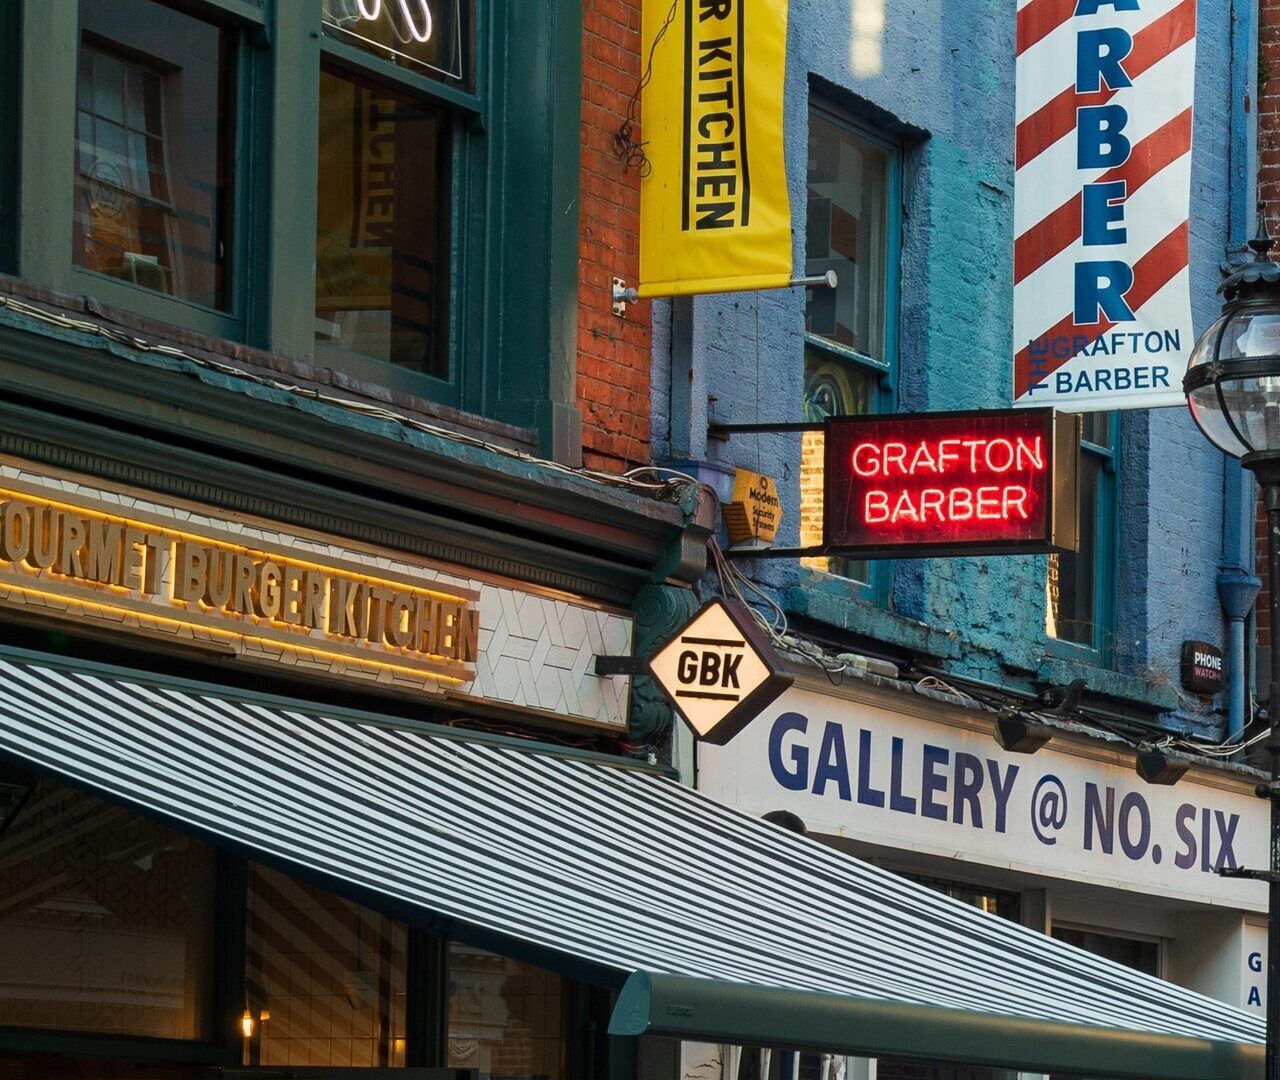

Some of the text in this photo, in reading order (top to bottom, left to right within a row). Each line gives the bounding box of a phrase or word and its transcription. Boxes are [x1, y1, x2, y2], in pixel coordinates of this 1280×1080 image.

[696, 36, 737, 230] KITCHEN
[1073, 0, 1139, 325] RBER
[1052, 328, 1181, 359] GRAFTON
[1056, 366, 1170, 394] BARBER
[852, 437, 1043, 476] GRAFTON
[864, 486, 1028, 524] BARBER
[171, 541, 326, 630] BURGER
[326, 577, 480, 664] KITCHEN
[677, 649, 743, 689] GBK
[1194, 651, 1222, 671] PHONE
[768, 711, 1240, 871] GALLERY @ NO. SIX
